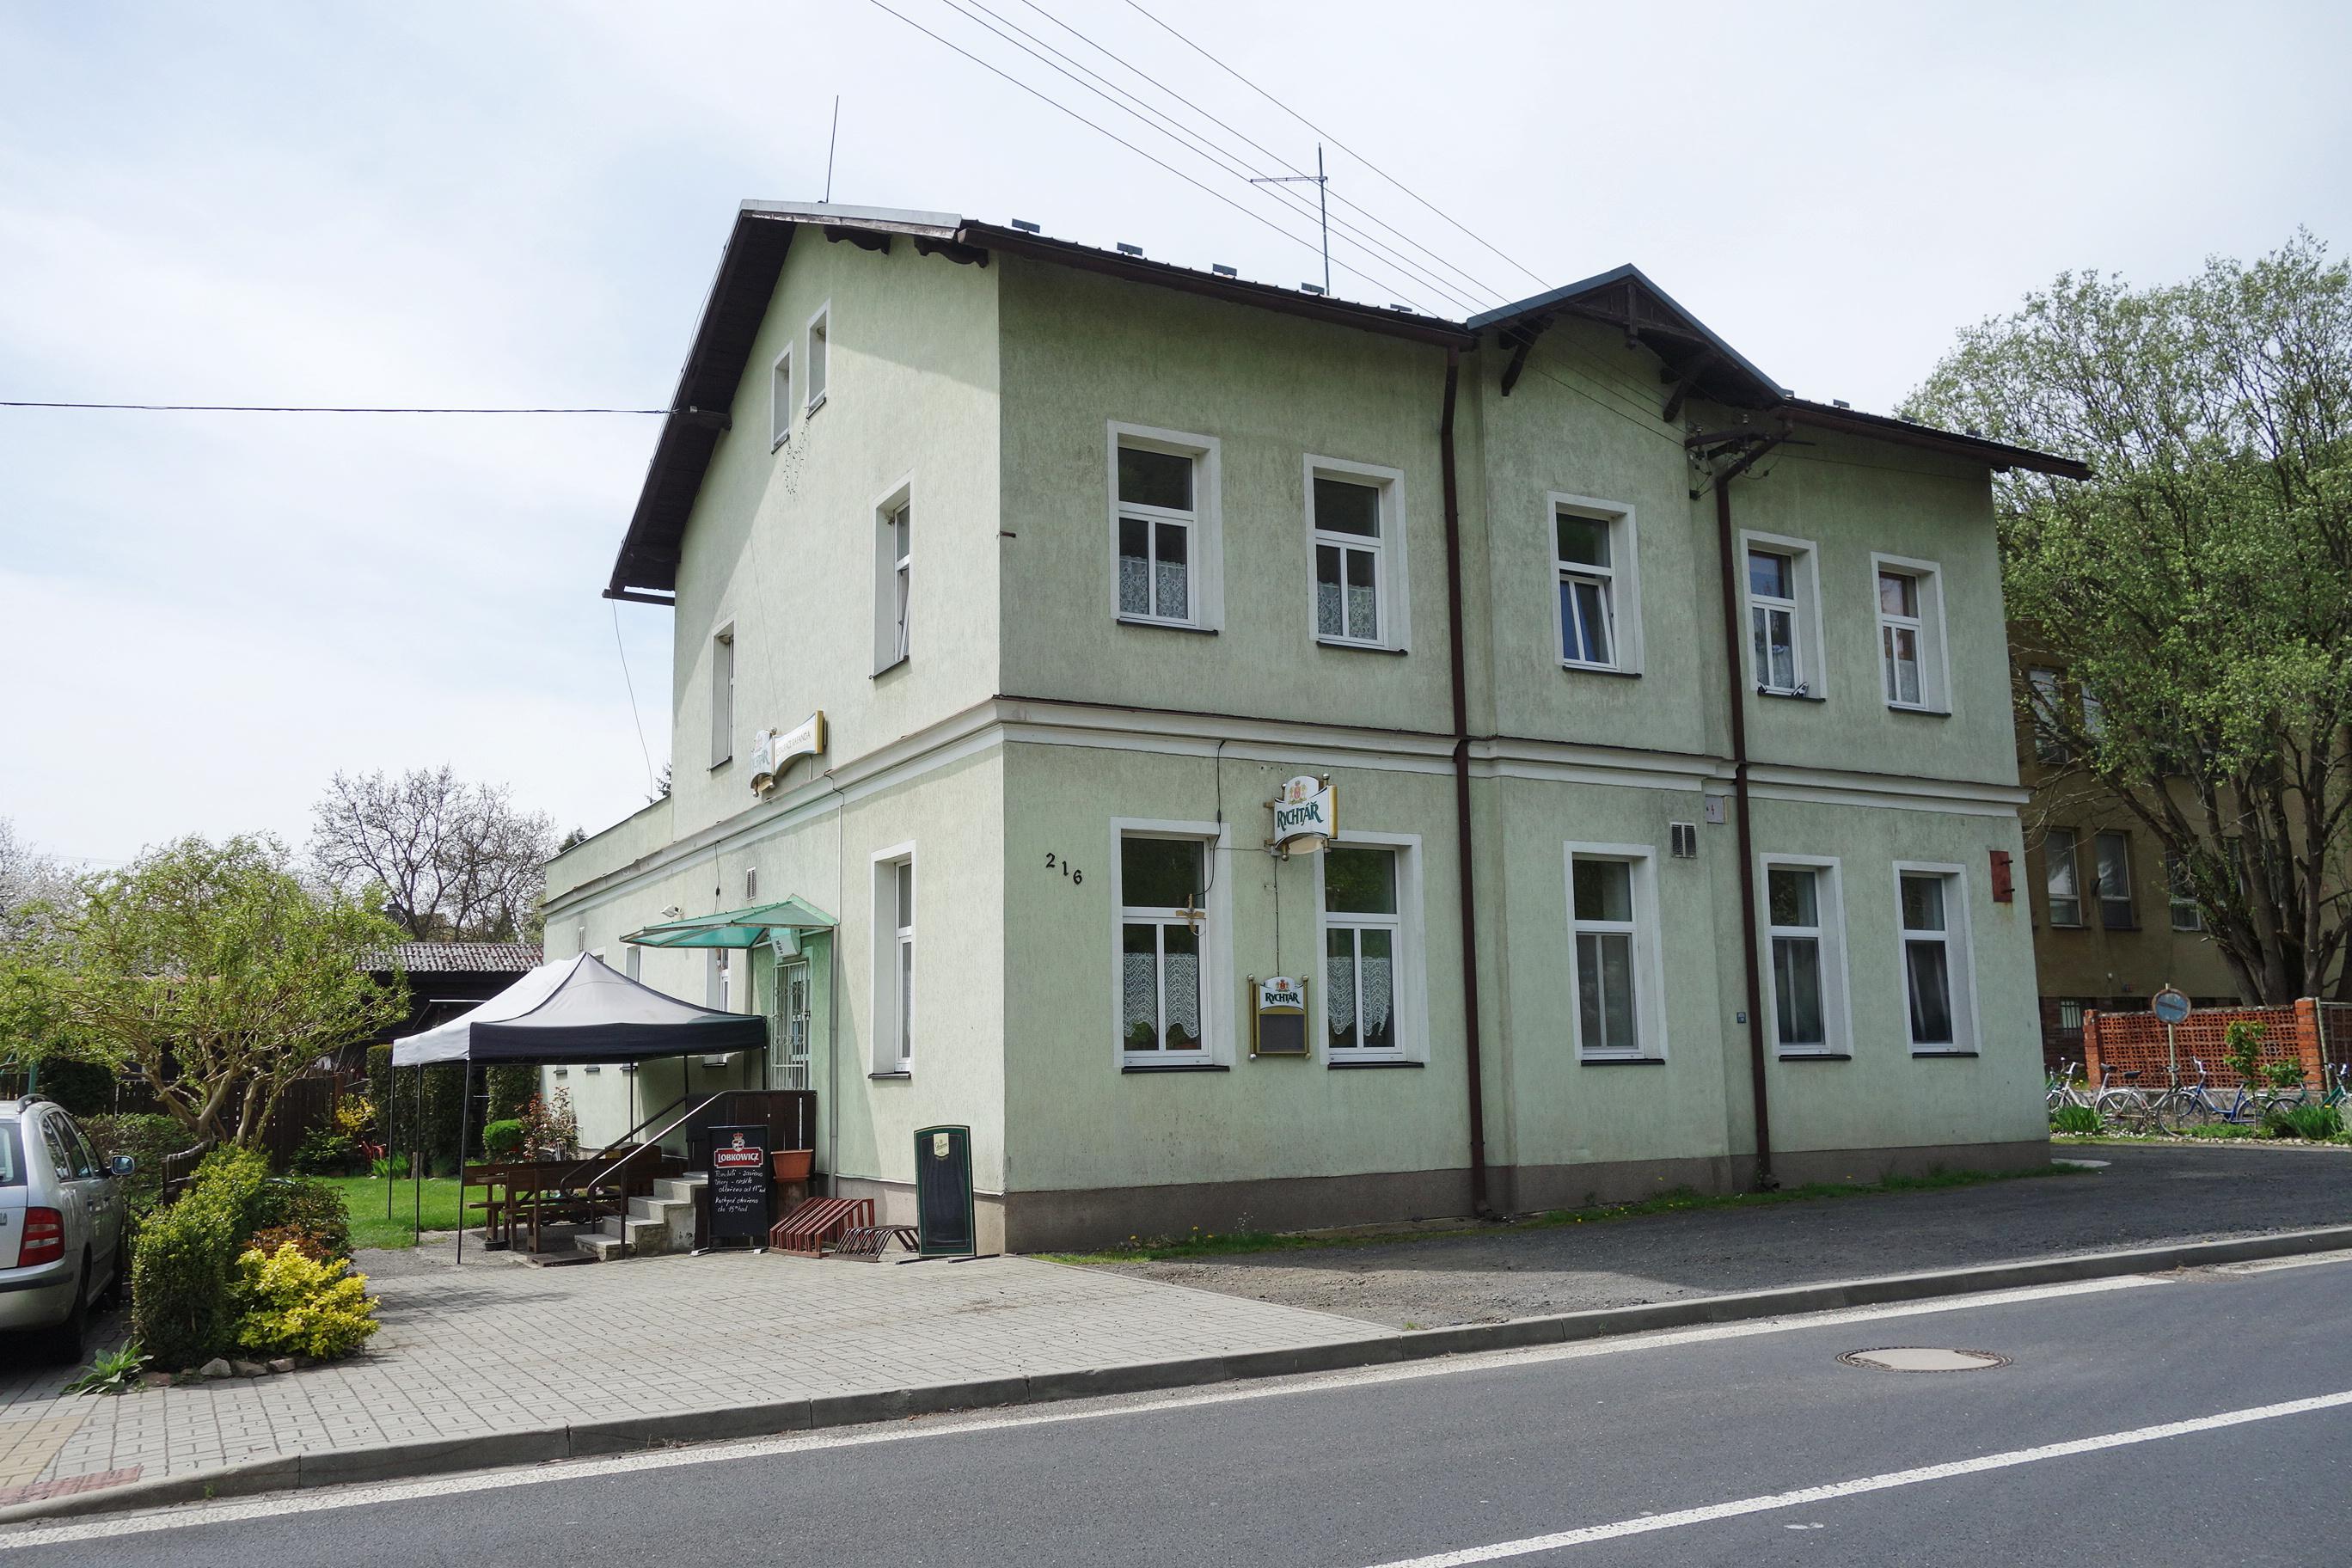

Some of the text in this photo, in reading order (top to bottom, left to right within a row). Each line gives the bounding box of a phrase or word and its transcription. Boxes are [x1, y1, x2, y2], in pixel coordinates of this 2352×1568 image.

[1277, 801, 1324, 831] RYCHTÁŘ
[1045, 852, 1082, 885] 216
[718, 1153, 759, 1162] LOBKOWICZ
